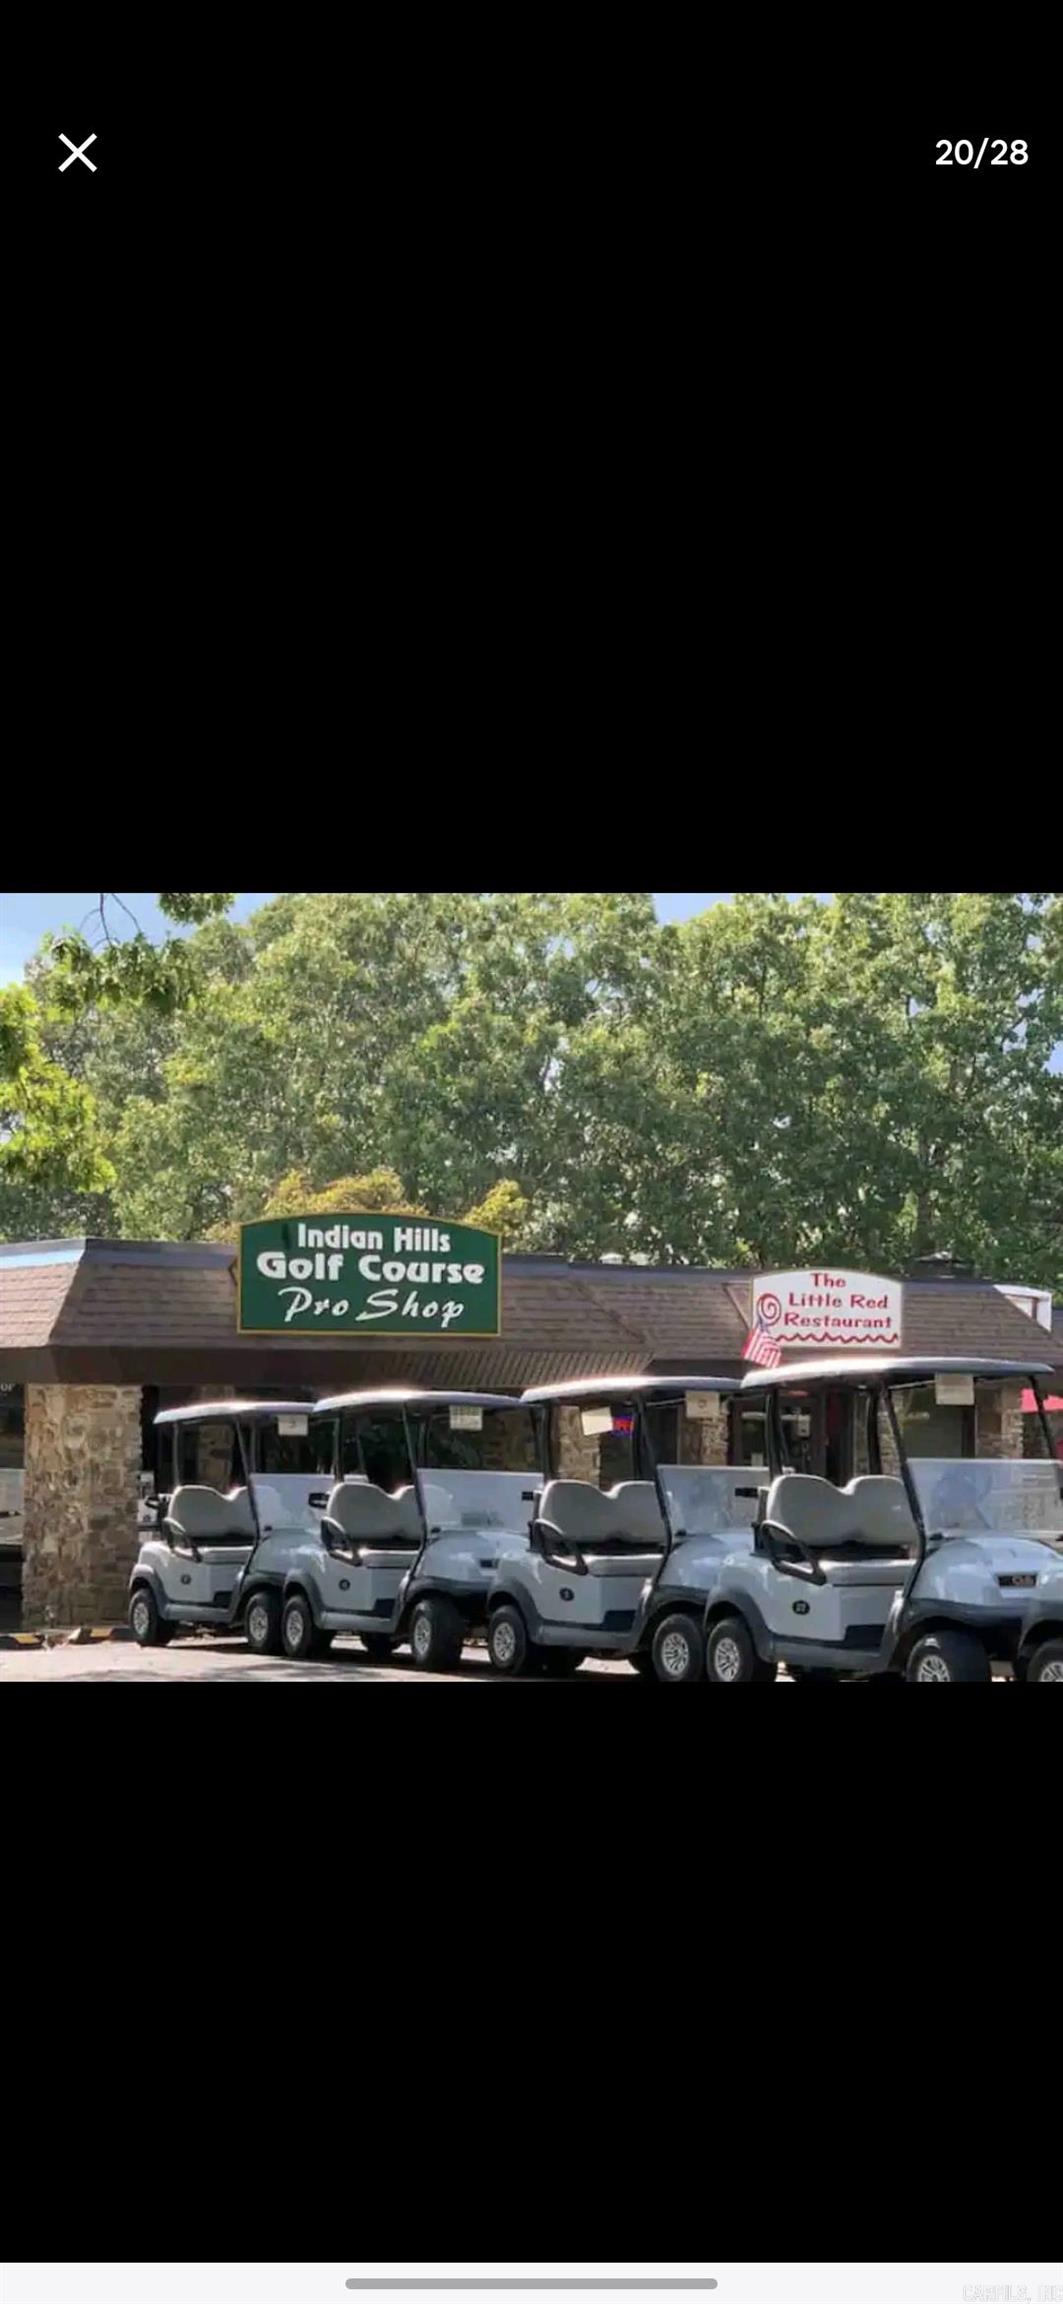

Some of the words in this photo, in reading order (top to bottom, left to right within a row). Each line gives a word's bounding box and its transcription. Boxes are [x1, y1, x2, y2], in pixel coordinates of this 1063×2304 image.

[298, 1223, 383, 1250] Indian
[393, 1227, 451, 1253] Hills
[256, 1251, 344, 1281] Golf
[358, 1254, 485, 1284] Course
[810, 1272, 847, 1288] The
[277, 1286, 349, 1322] Pro
[355, 1288, 464, 1328] Shop
[788, 1292, 842, 1308] Little
[849, 1294, 888, 1309] Red
[783, 1312, 892, 1329] Restaurant
